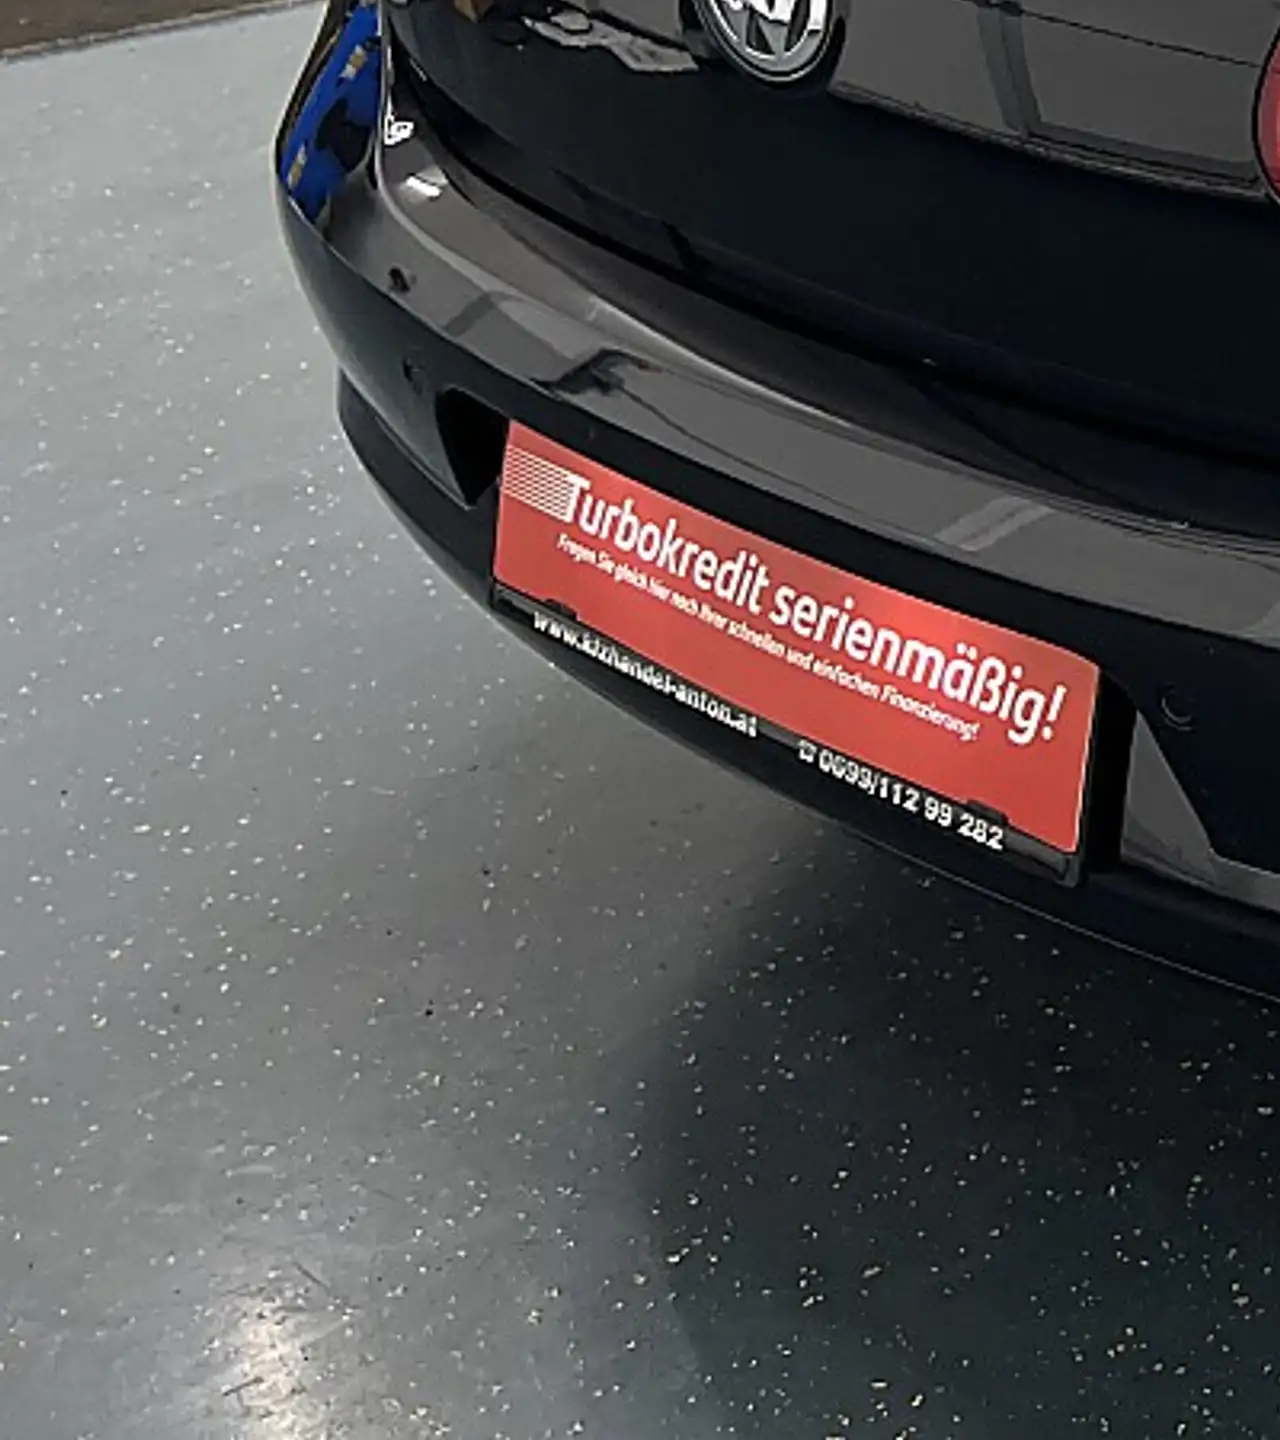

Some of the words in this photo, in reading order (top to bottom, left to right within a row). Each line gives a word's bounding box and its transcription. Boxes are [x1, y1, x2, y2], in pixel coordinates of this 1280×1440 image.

[557, 533, 596, 564] Fragen
[596, 551, 615, 574] Sie
[614, 563, 648, 590] gleich
[647, 577, 671, 601] hier
[670, 592, 699, 615] nach
[727, 621, 785, 657] schnellen
[786, 649, 814, 670] und
[813, 659, 880, 699] einfachen
[880, 685, 980, 741] Finanzierung!
[558, 473, 770, 615] Turbokredit
[768, 585, 1067, 745] serienmäßig!
[957, 812, 1004, 850] 282
